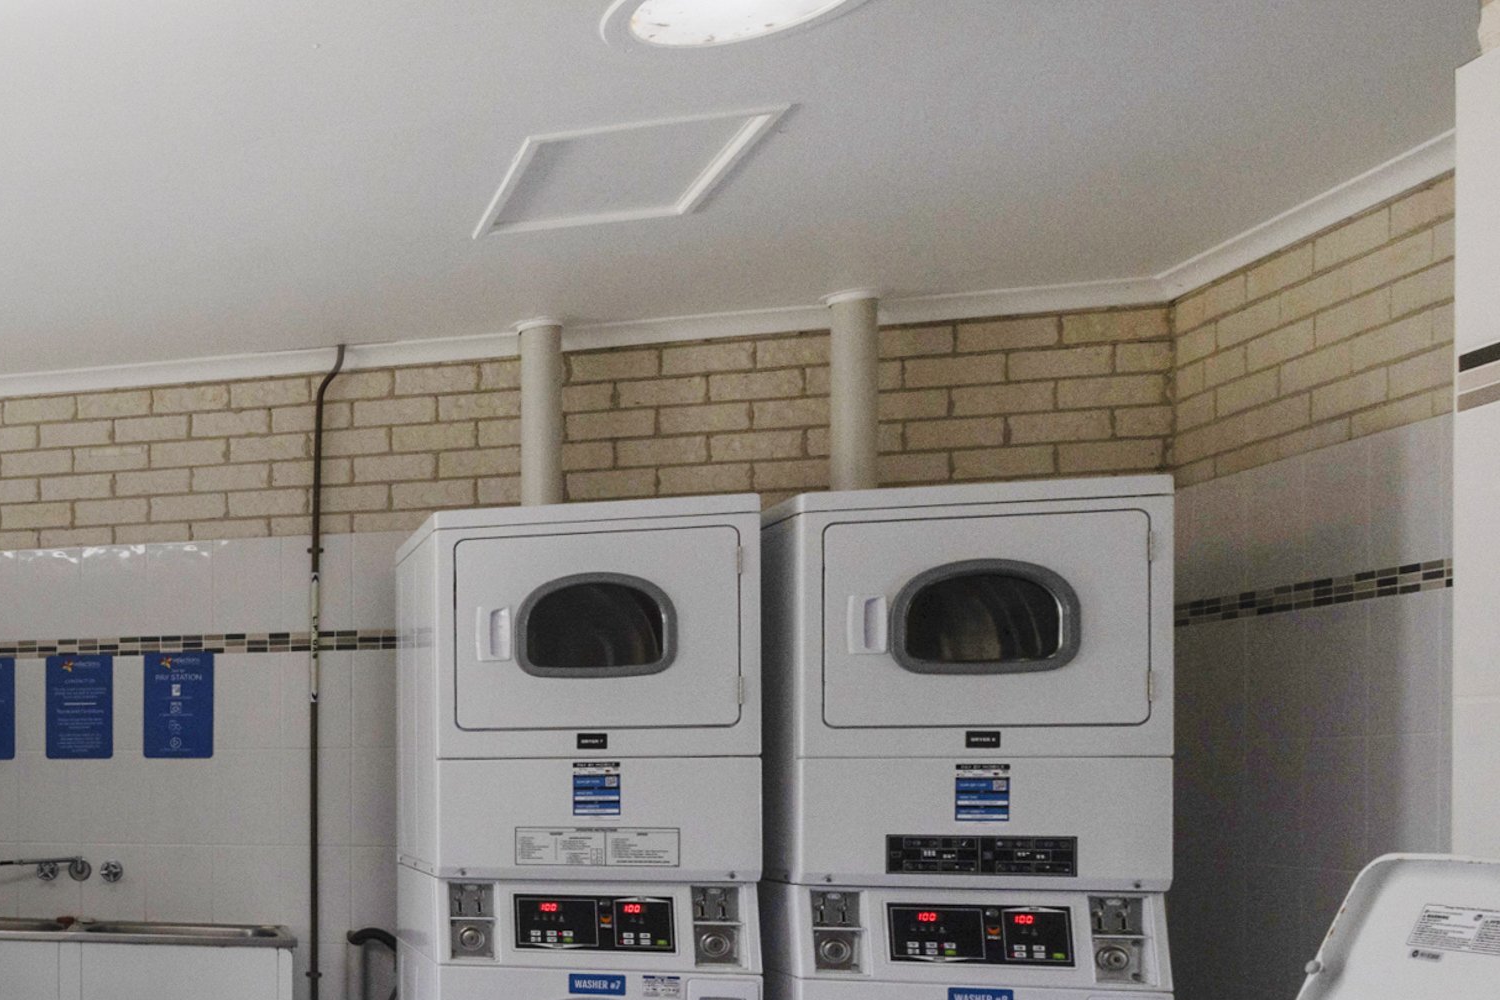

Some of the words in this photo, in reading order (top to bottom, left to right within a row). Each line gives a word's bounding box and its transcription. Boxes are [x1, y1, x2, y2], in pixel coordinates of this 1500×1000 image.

[170, 673, 202, 681] STATION
[541, 903, 557, 912] 100
[624, 904, 640, 913] 100
[918, 912, 936, 922] 100
[1015, 915, 1034, 924] 100
[574, 979, 608, 990] WASHER
[609, 980, 621, 991] #7
